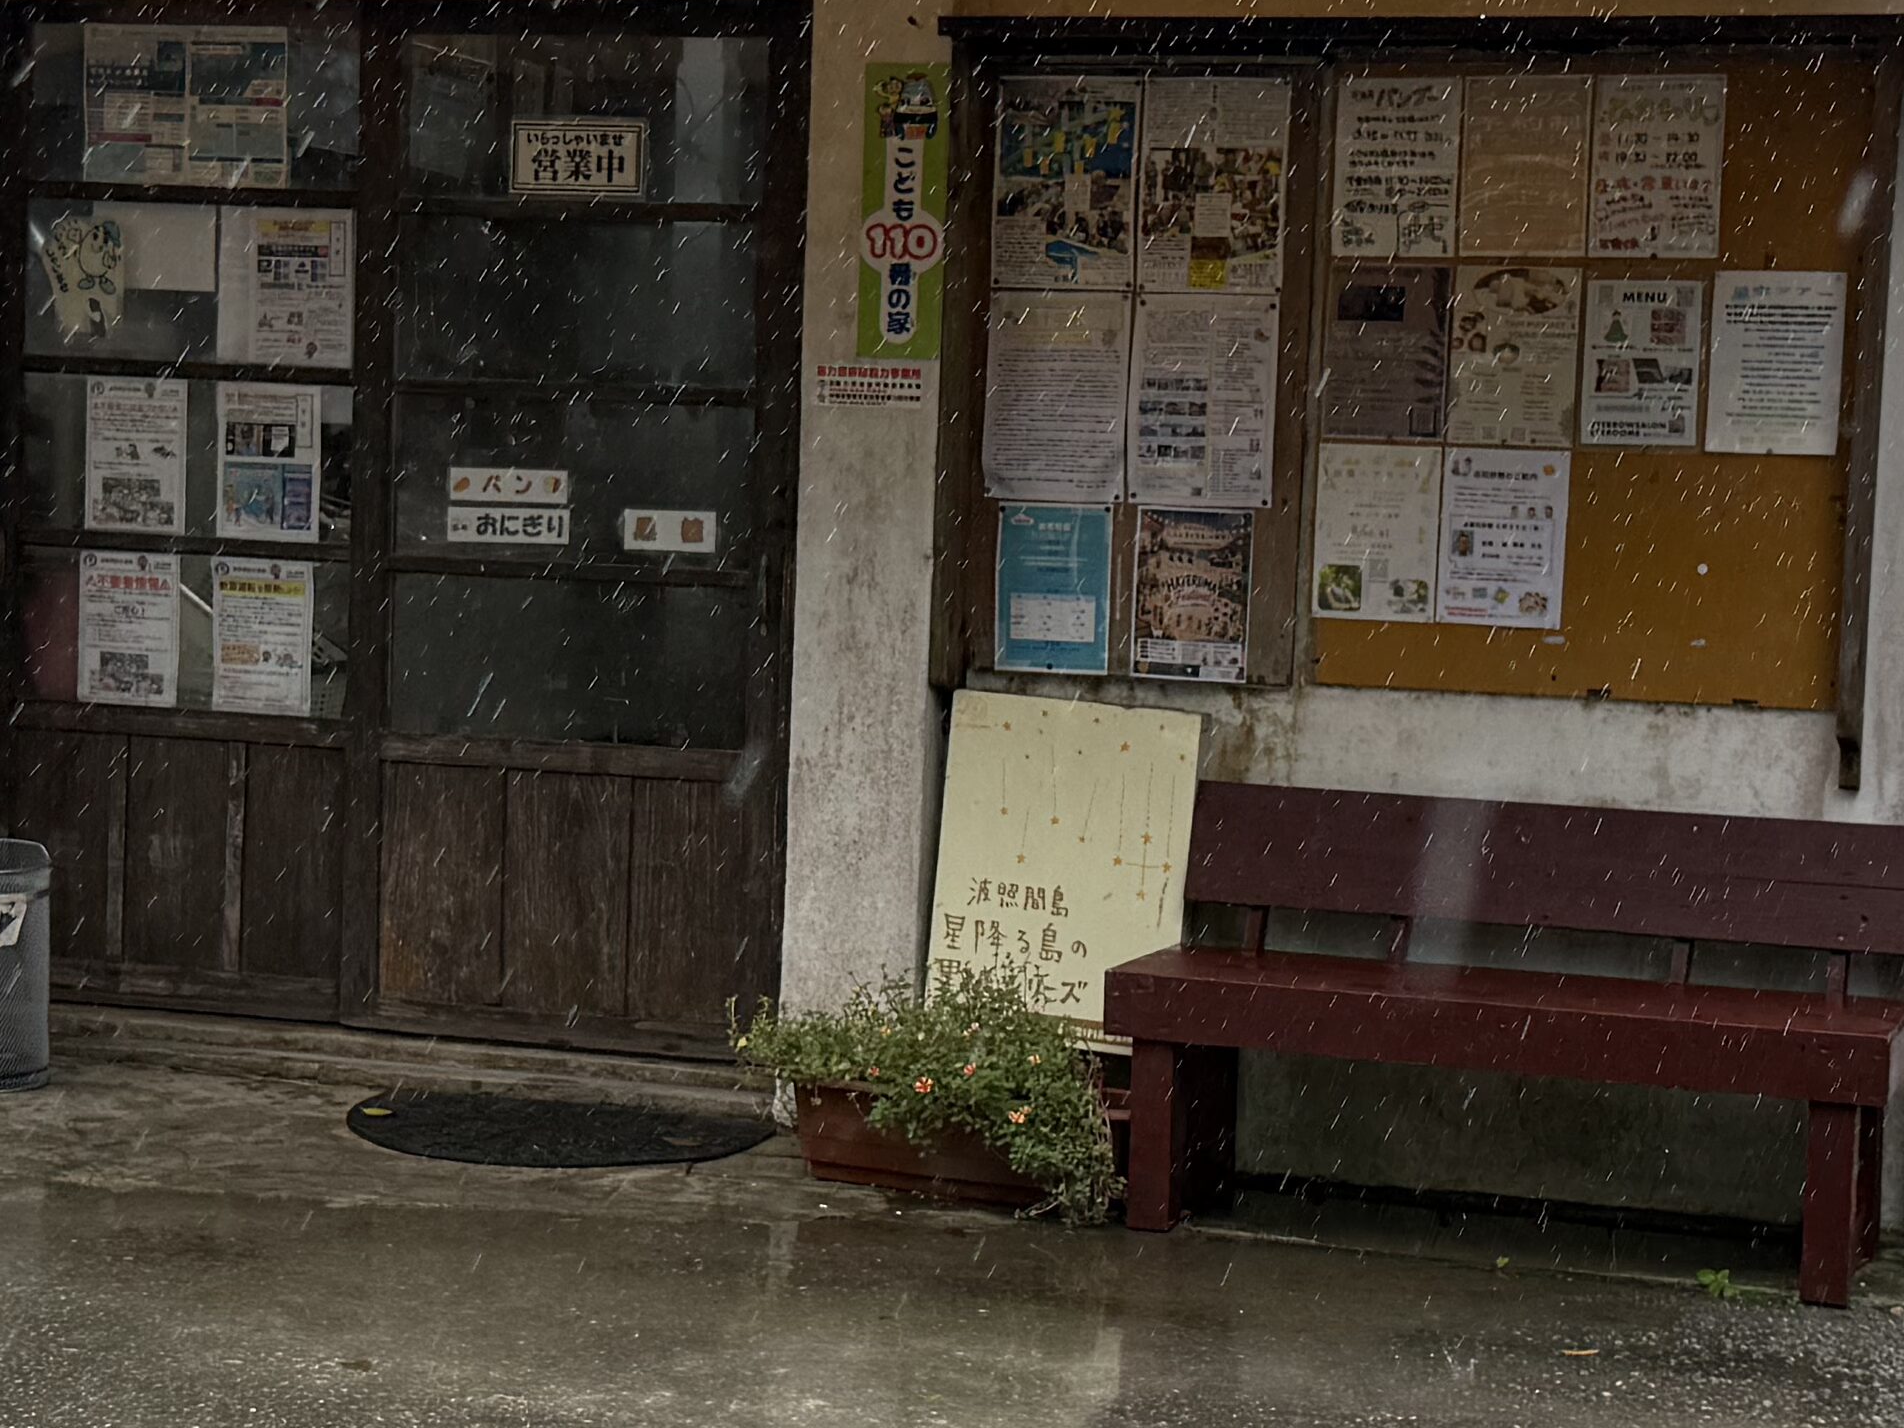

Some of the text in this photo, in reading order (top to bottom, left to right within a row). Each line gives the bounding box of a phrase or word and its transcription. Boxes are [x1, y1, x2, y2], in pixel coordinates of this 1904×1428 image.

[527, 132, 624, 147] いらっしゃいませ
[531, 148, 625, 183] 営業中
[1622, 292, 1667, 303] MENU
[483, 474, 532, 494] パン
[476, 513, 564, 538] おにぎり
[967, 877, 1069, 918] 波照間島
[943, 914, 1087, 964] 星降る島の
